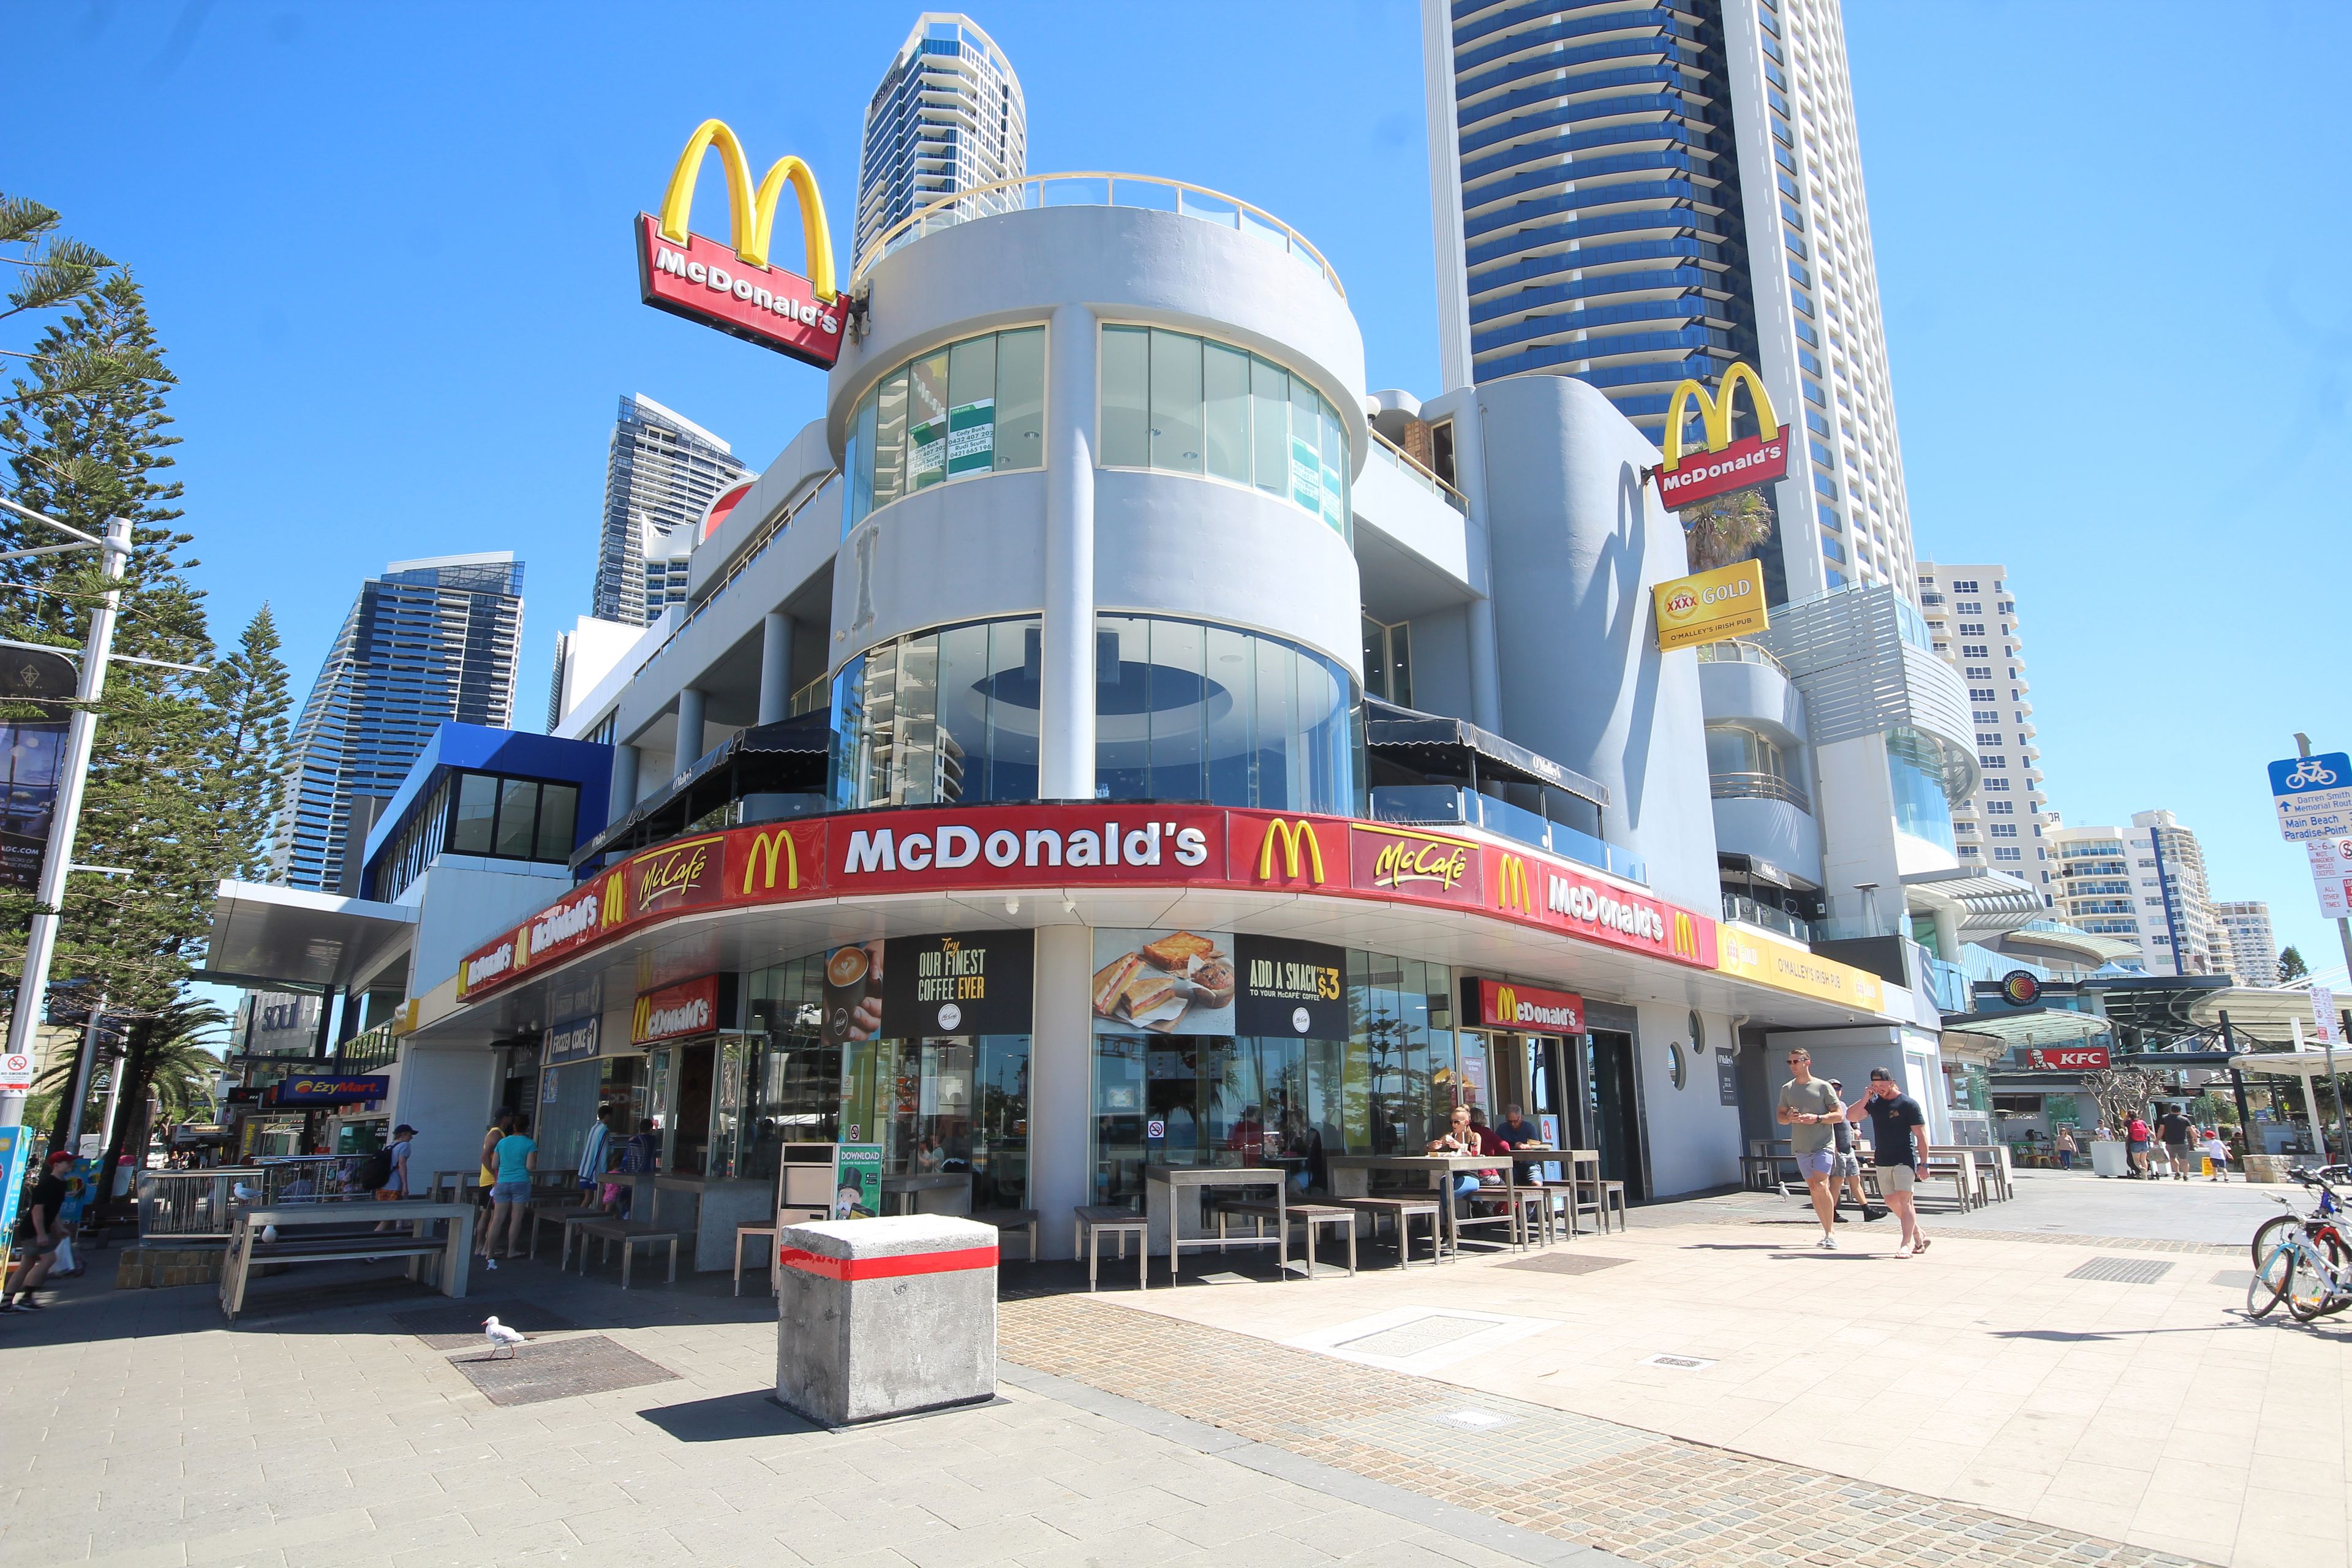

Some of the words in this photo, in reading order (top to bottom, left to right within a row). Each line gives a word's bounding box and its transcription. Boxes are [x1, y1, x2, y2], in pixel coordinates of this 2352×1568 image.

[656, 246, 839, 334] McDonald's
[948, 436, 965, 445] 0432
[956, 429, 971, 438] Cody
[970, 439, 986, 447] Scutti
[926, 454, 940, 463] Scutti
[1663, 445, 1782, 492] McDonald's
[1702, 579, 1751, 605] GOLD
[1666, 597, 1698, 612] XXXX
[1671, 626, 1714, 641] O'MALLEY'S
[1715, 622, 1735, 631] IRISH
[1737, 617, 1752, 626] PUB
[2294, 802, 2331, 813] Memorial
[2297, 794, 2324, 804] Darren
[2326, 791, 2351, 801] Smith
[2284, 829, 2322, 840] Paradise
[2324, 824, 2348, 835] Point
[2285, 819, 2307, 829] Main
[2310, 815, 2339, 826] Beach
[843, 821, 1208, 875] McDonald's
[639, 846, 707, 908] McCafé
[1374, 840, 1468, 890] McCafé
[1548, 873, 1665, 941] McDonald's
[941, 937, 960, 957] Try
[919, 951, 941, 978] OUR
[944, 949, 986, 976] FINEST
[1777, 958, 1814, 982] O'MALLEY'S
[1815, 968, 1830, 986] IRISH
[1831, 974, 1841, 989] PUB
[1250, 959, 1273, 988] ADD
[1276, 962, 1283, 989] A
[1286, 962, 1317, 993] SNACK
[1318, 967, 1340, 1000] $3
[2030, 977, 2040, 991] GRILL
[918, 977, 954, 1001] COFFEE
[957, 976, 985, 1000] EVER
[261, 995, 300, 1033] soul
[1498, 986, 1576, 1027] McDonald's
[552, 1032, 570, 1054] FROZEN
[572, 1028, 587, 1050] COKE
[2059, 1052, 2101, 1065] KFC
[312, 1082, 377, 1095] EzyMart
[245, 1124, 255, 1148] Believe
[841, 1152, 880, 1160] DOWNLOAD
